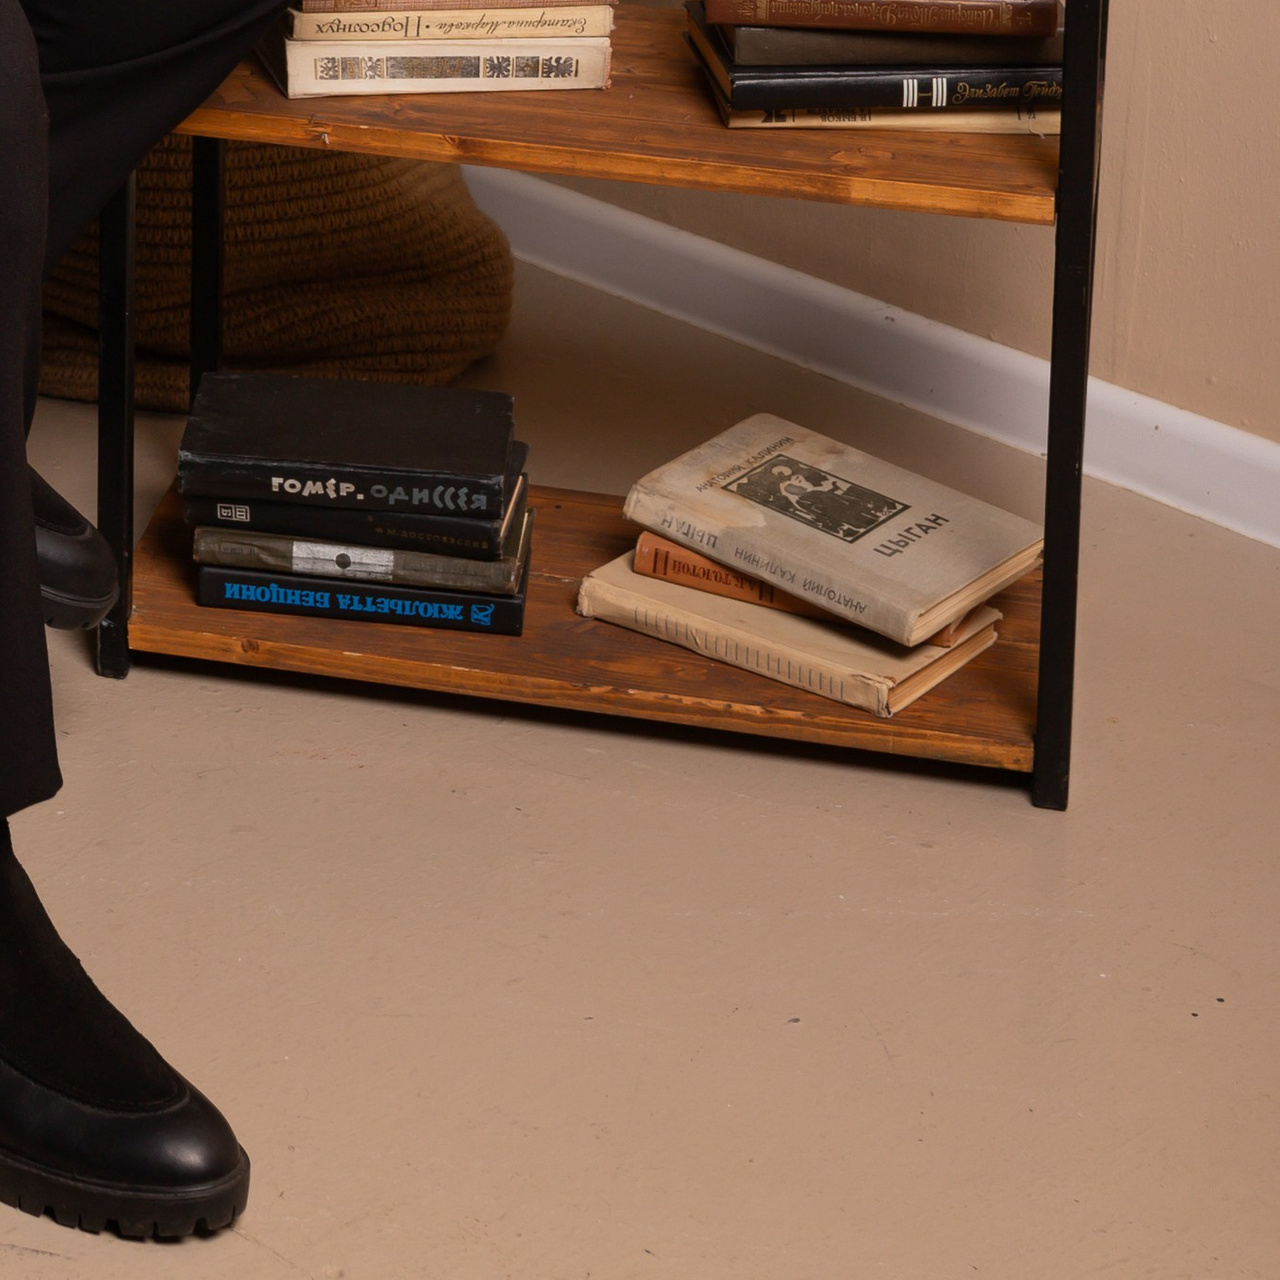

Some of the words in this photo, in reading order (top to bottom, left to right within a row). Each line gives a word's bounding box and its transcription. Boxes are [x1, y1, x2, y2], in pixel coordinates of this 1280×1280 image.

[315, 16, 422, 37] Подсолнух
[436, 13, 506, 34] Маркова
[504, 12, 588, 34] Екатерина
[952, 81, 1019, 104] Элизабет
[695, 464, 746, 493] АНАТОЛИЙ
[746, 436, 795, 469] КАЛИНИН
[370, 484, 487, 511] ОДИССЕЯ
[661, 514, 719, 547] ЦЫГАН
[873, 513, 950, 558] ЦЫГАН
[734, 546, 796, 584] КАЛИНИН
[224, 582, 331, 608] БЕНЦОНИ
[336, 594, 464, 621] ЖЮЛЬЕТТА
[802, 578, 868, 615] АНАТОЛИЙ
